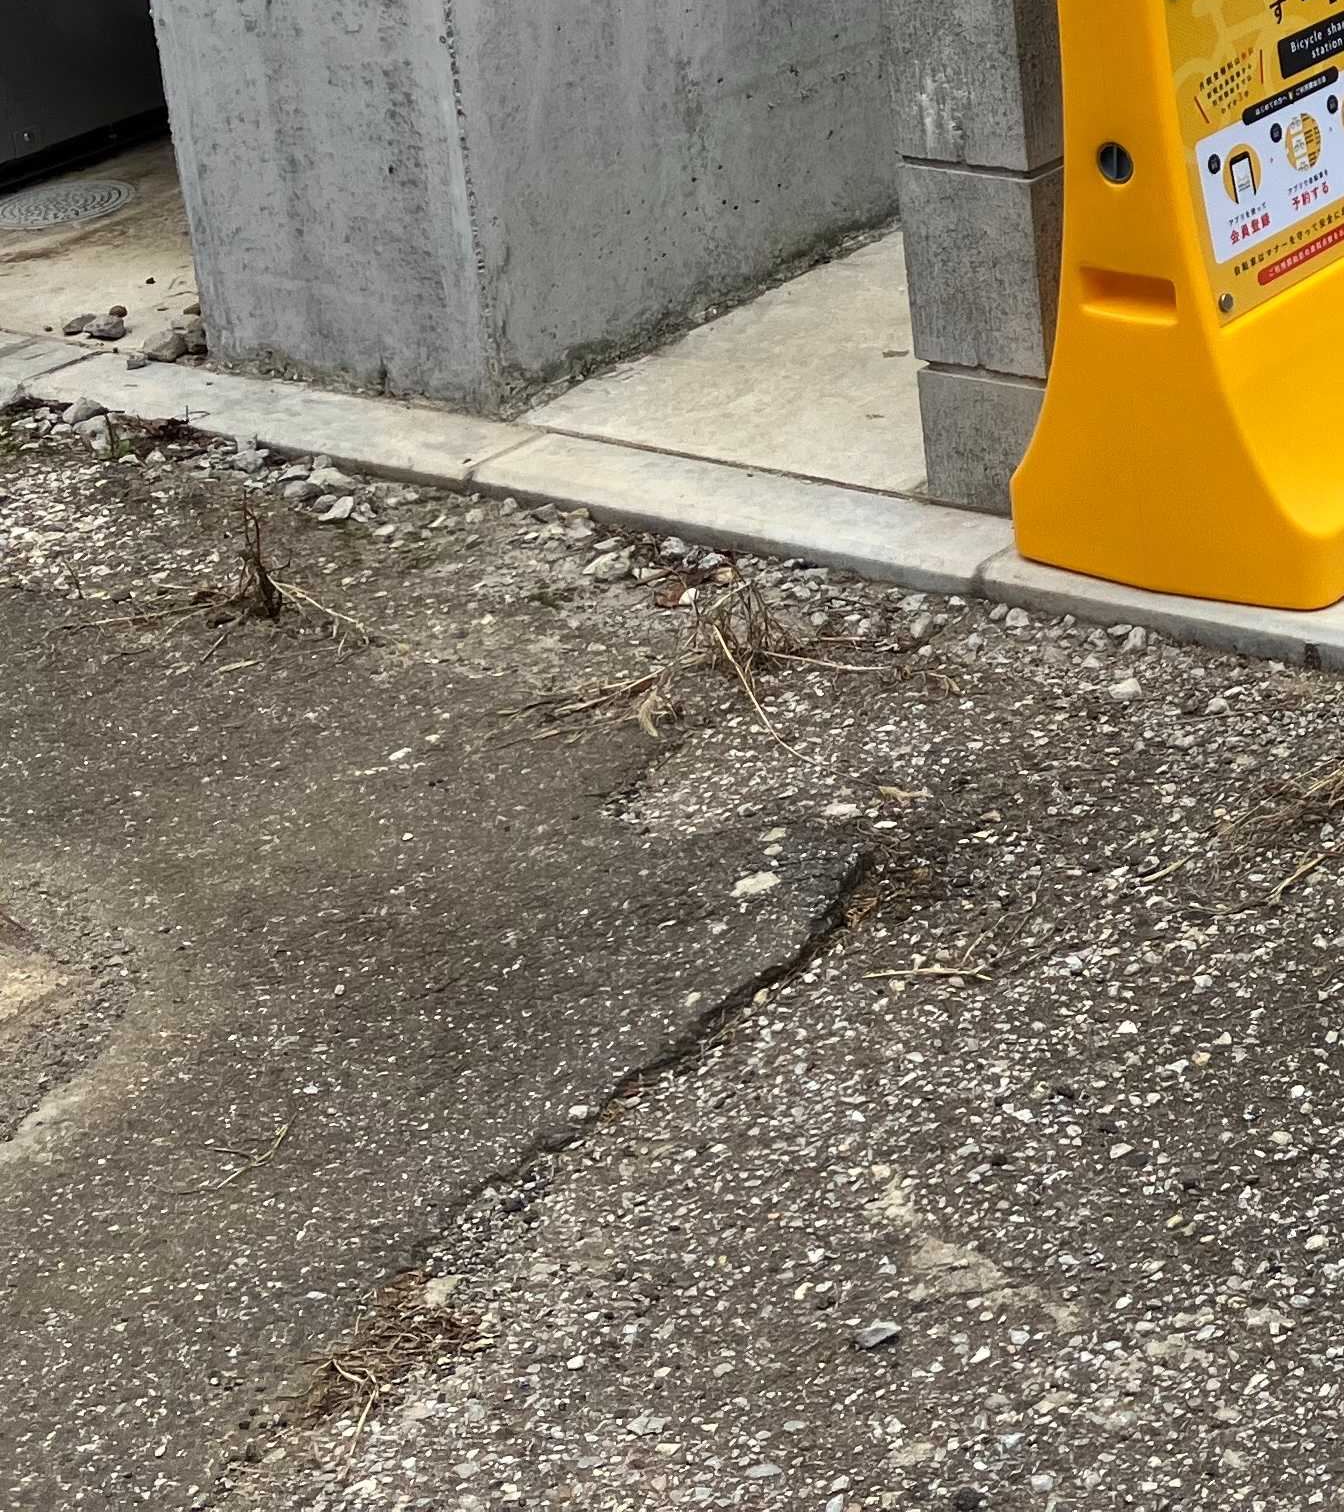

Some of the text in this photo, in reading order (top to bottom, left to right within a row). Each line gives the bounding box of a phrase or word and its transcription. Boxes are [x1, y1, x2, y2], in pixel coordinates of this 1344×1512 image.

[1290, 29, 1322, 53] Bicycle
[1311, 37, 1343, 59] station
[1291, 181, 1330, 211] 予約する
[1230, 212, 1271, 245] 会員登録
